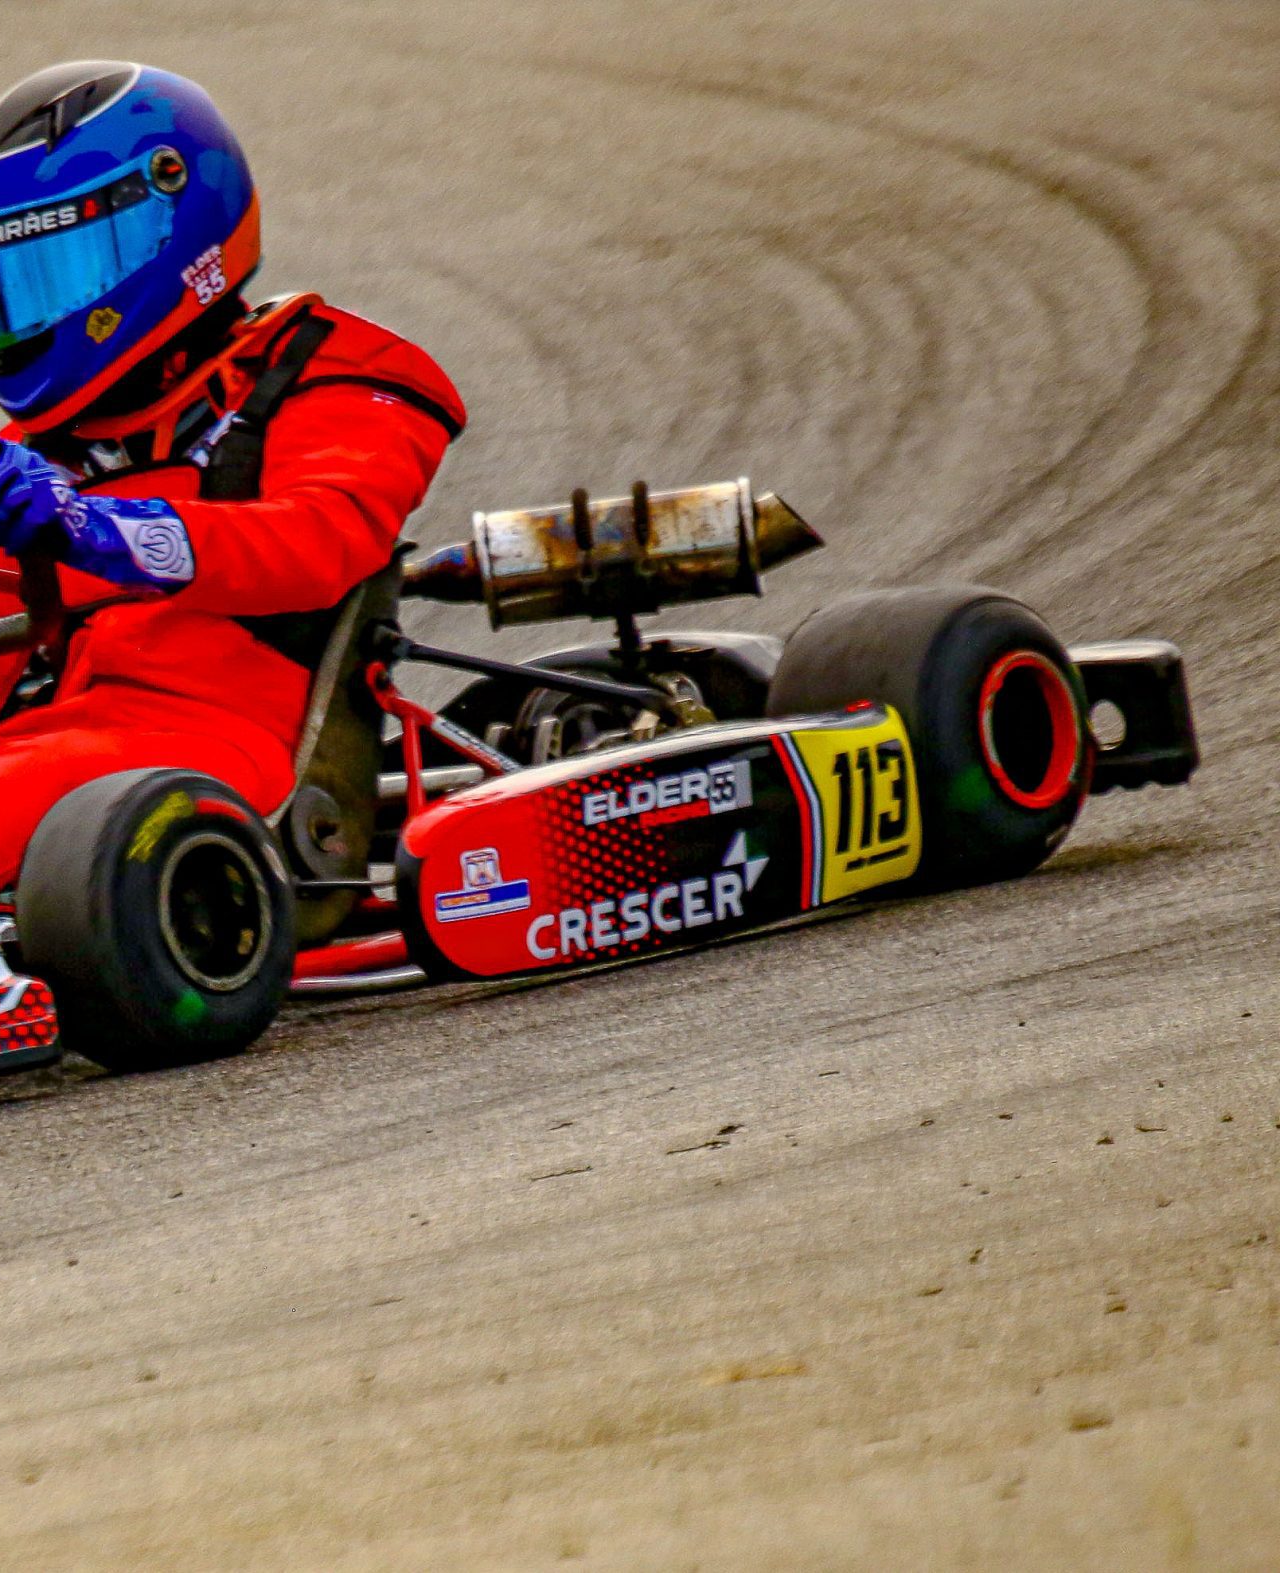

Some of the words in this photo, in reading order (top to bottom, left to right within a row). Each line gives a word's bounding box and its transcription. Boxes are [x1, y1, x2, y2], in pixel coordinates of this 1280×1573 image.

[584, 771, 709, 826] ELDER
[833, 738, 909, 856] 113
[526, 872, 745, 960] CRESCER
